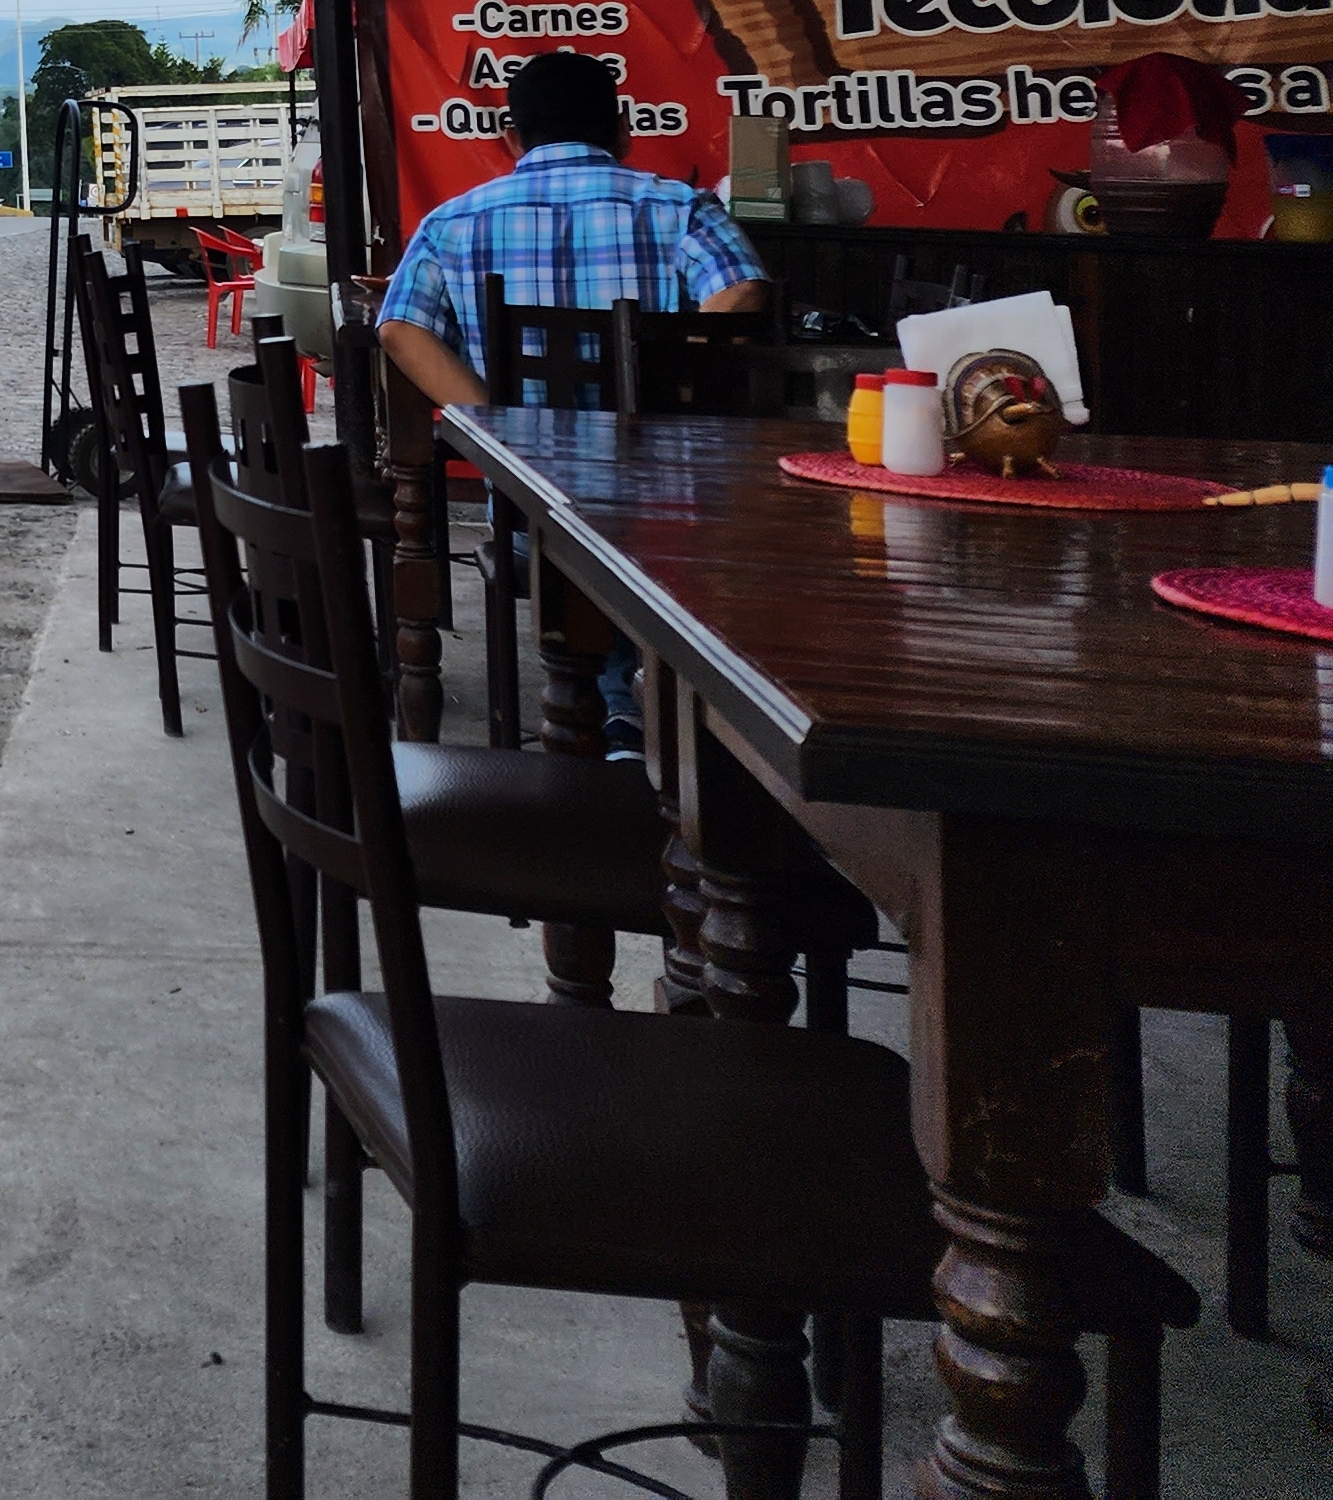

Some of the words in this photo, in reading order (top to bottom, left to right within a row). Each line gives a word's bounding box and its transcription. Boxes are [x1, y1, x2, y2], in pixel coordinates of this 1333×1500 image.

[471, 50, 626, 86] Ass
[721, 71, 1001, 127] Tortillas
[1283, 67, 1327, 113] a
